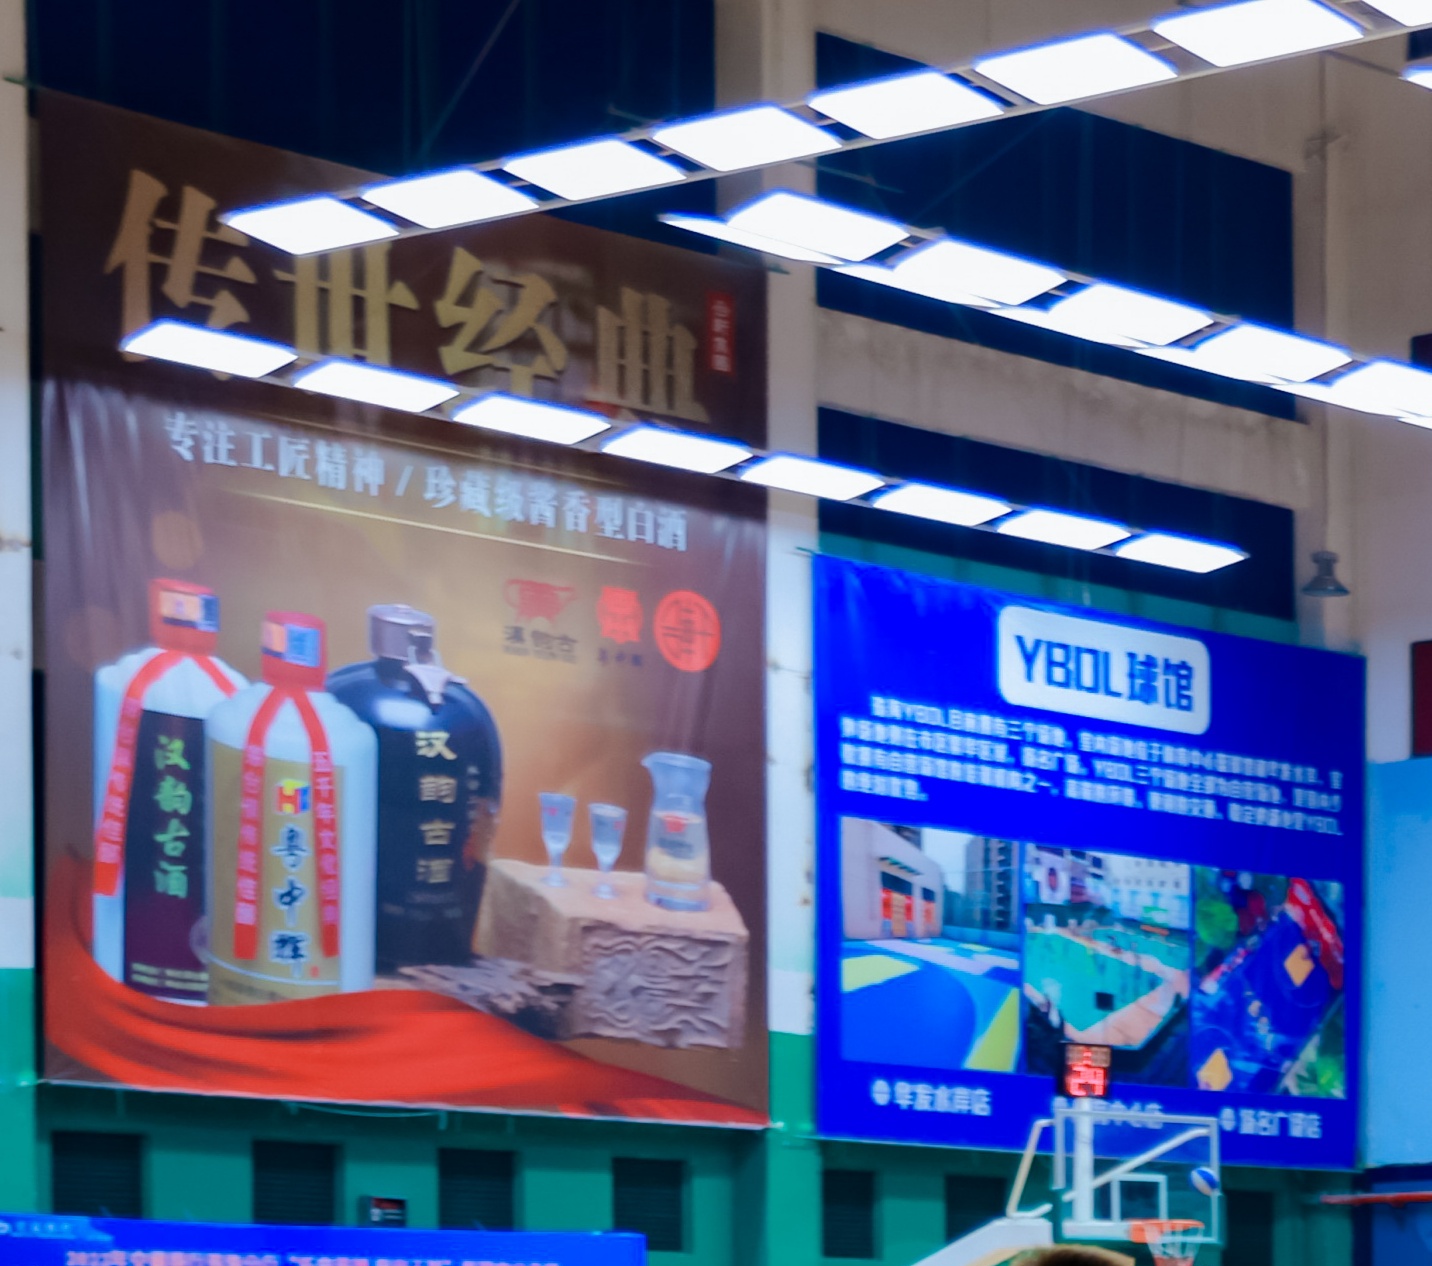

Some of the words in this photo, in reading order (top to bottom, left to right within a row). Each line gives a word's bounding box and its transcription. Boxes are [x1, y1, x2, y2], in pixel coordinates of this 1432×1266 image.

[164, 411, 385, 497] 专注工匠精神
